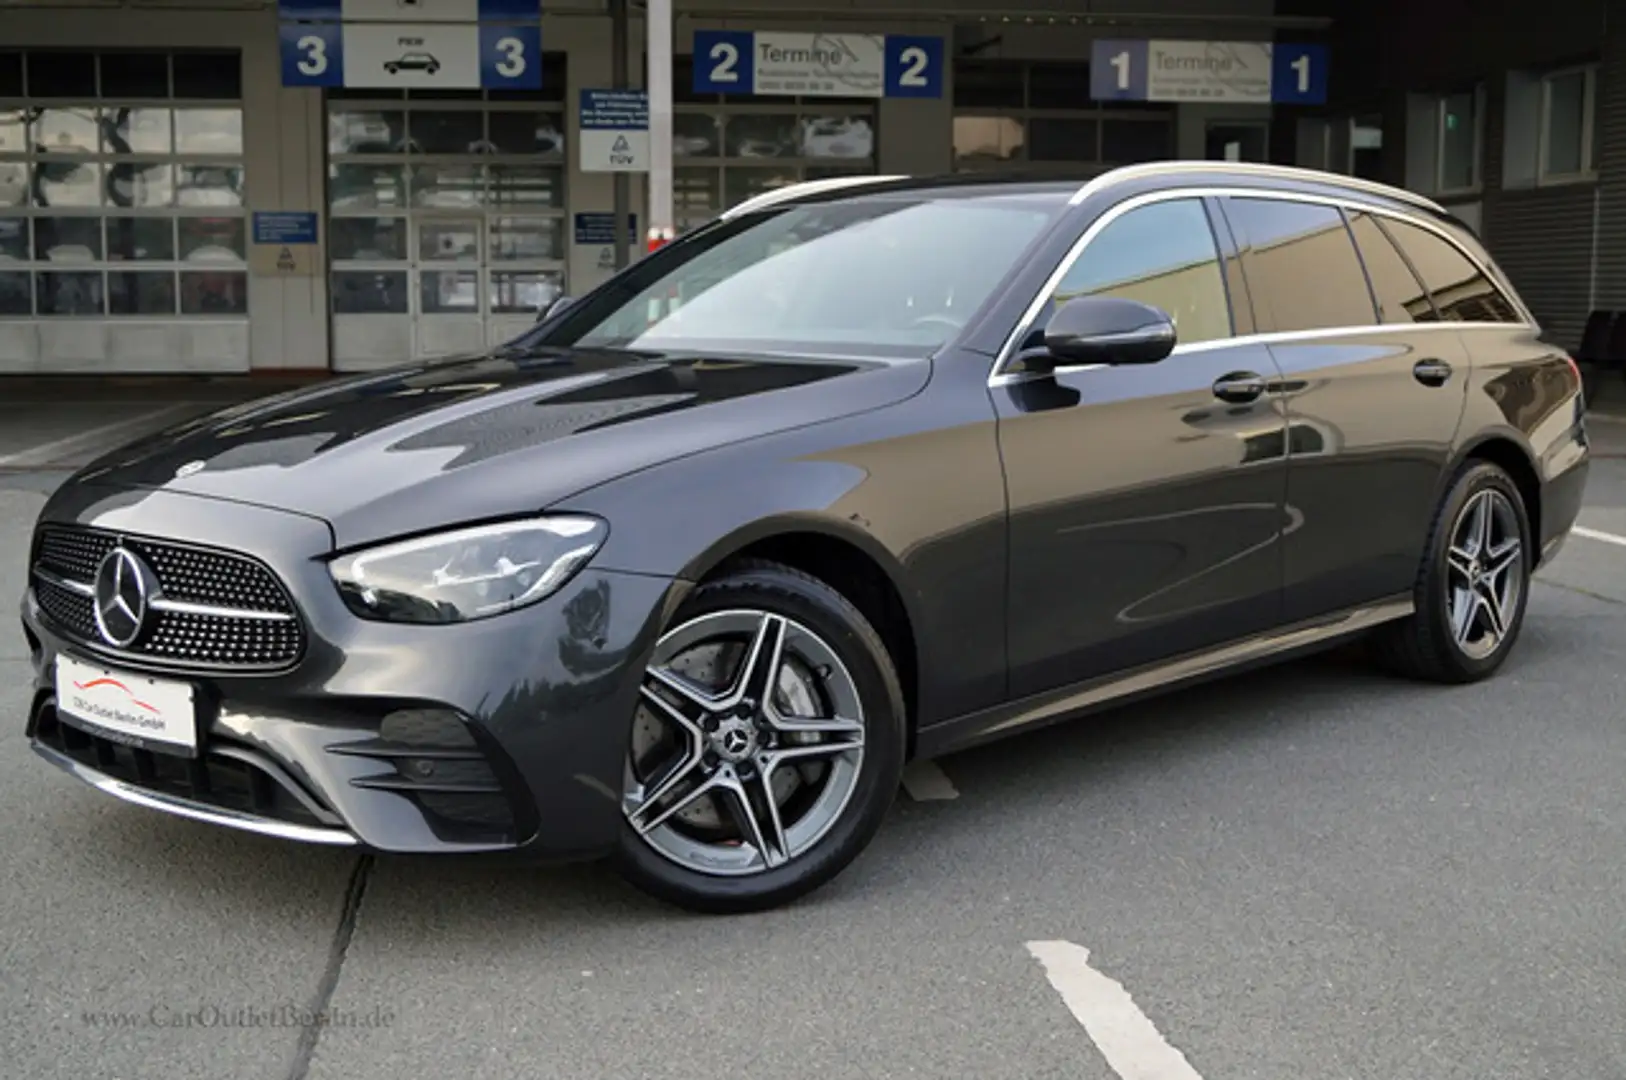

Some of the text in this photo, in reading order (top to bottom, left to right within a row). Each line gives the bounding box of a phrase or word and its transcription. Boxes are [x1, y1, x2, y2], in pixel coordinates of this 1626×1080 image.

[297, 35, 328, 76] 3
[495, 37, 526, 78] 3
[709, 42, 739, 82] 2
[760, 44, 842, 64] Termine
[899, 47, 928, 86] 2
[1110, 51, 1130, 90] 1
[1155, 51, 1232, 70] Termine
[1291, 55, 1310, 92] 1
